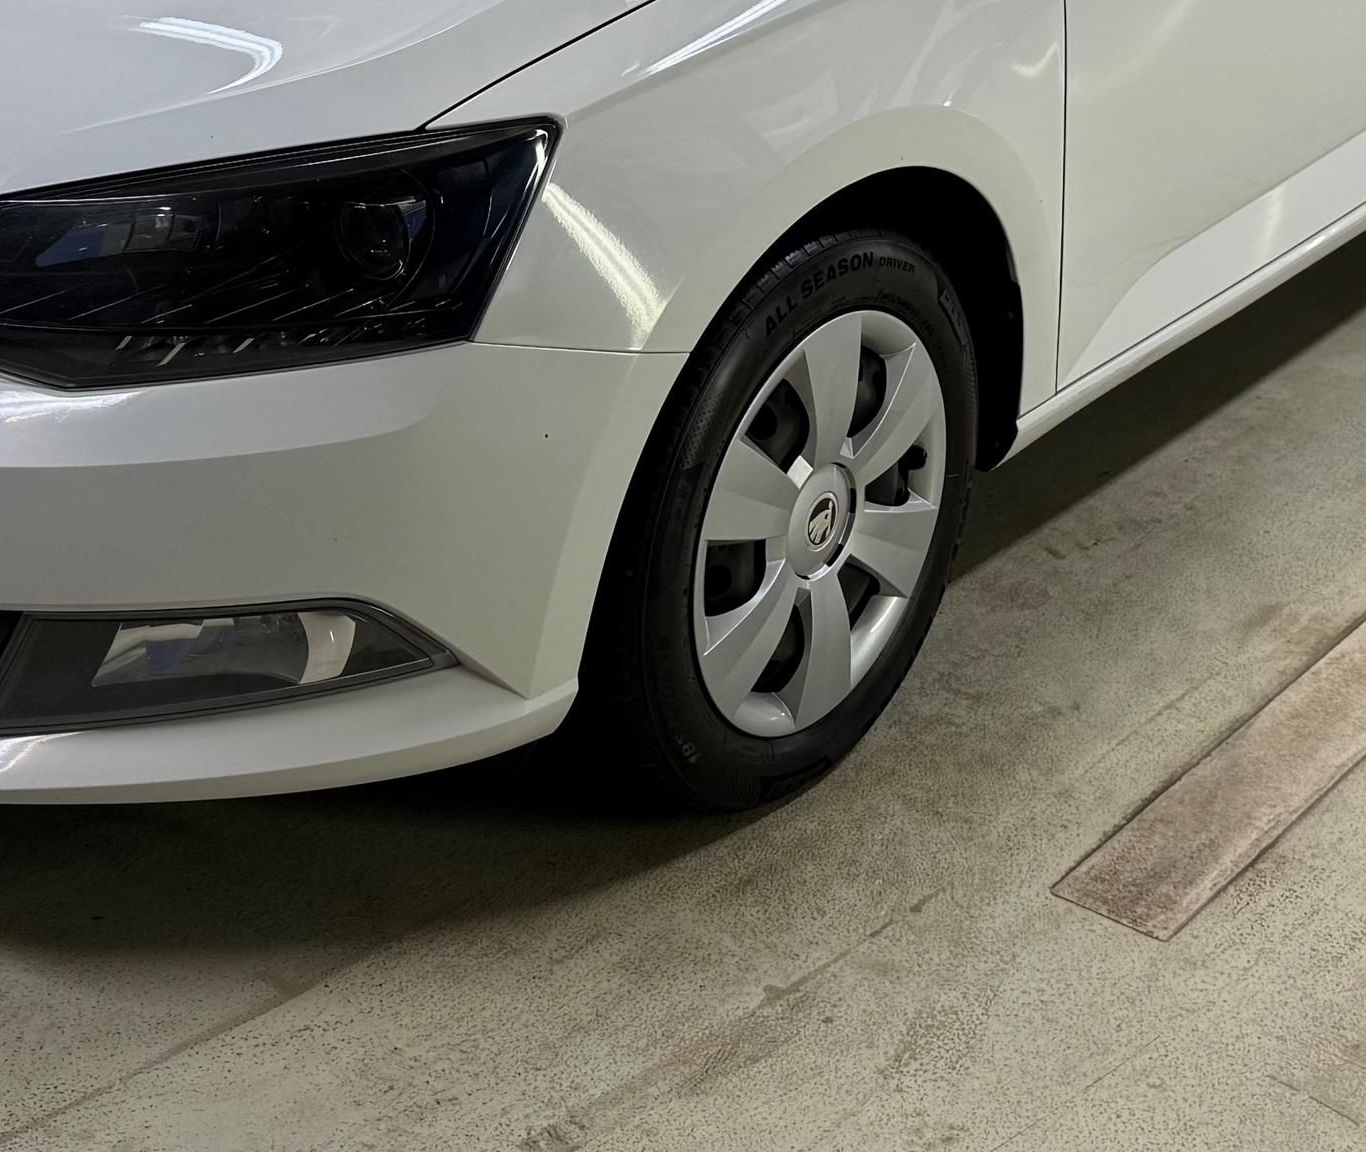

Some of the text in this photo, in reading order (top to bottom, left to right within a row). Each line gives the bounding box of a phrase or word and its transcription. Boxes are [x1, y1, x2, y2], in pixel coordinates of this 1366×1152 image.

[765, 251, 916, 337] ALL SEASON DRIVER
